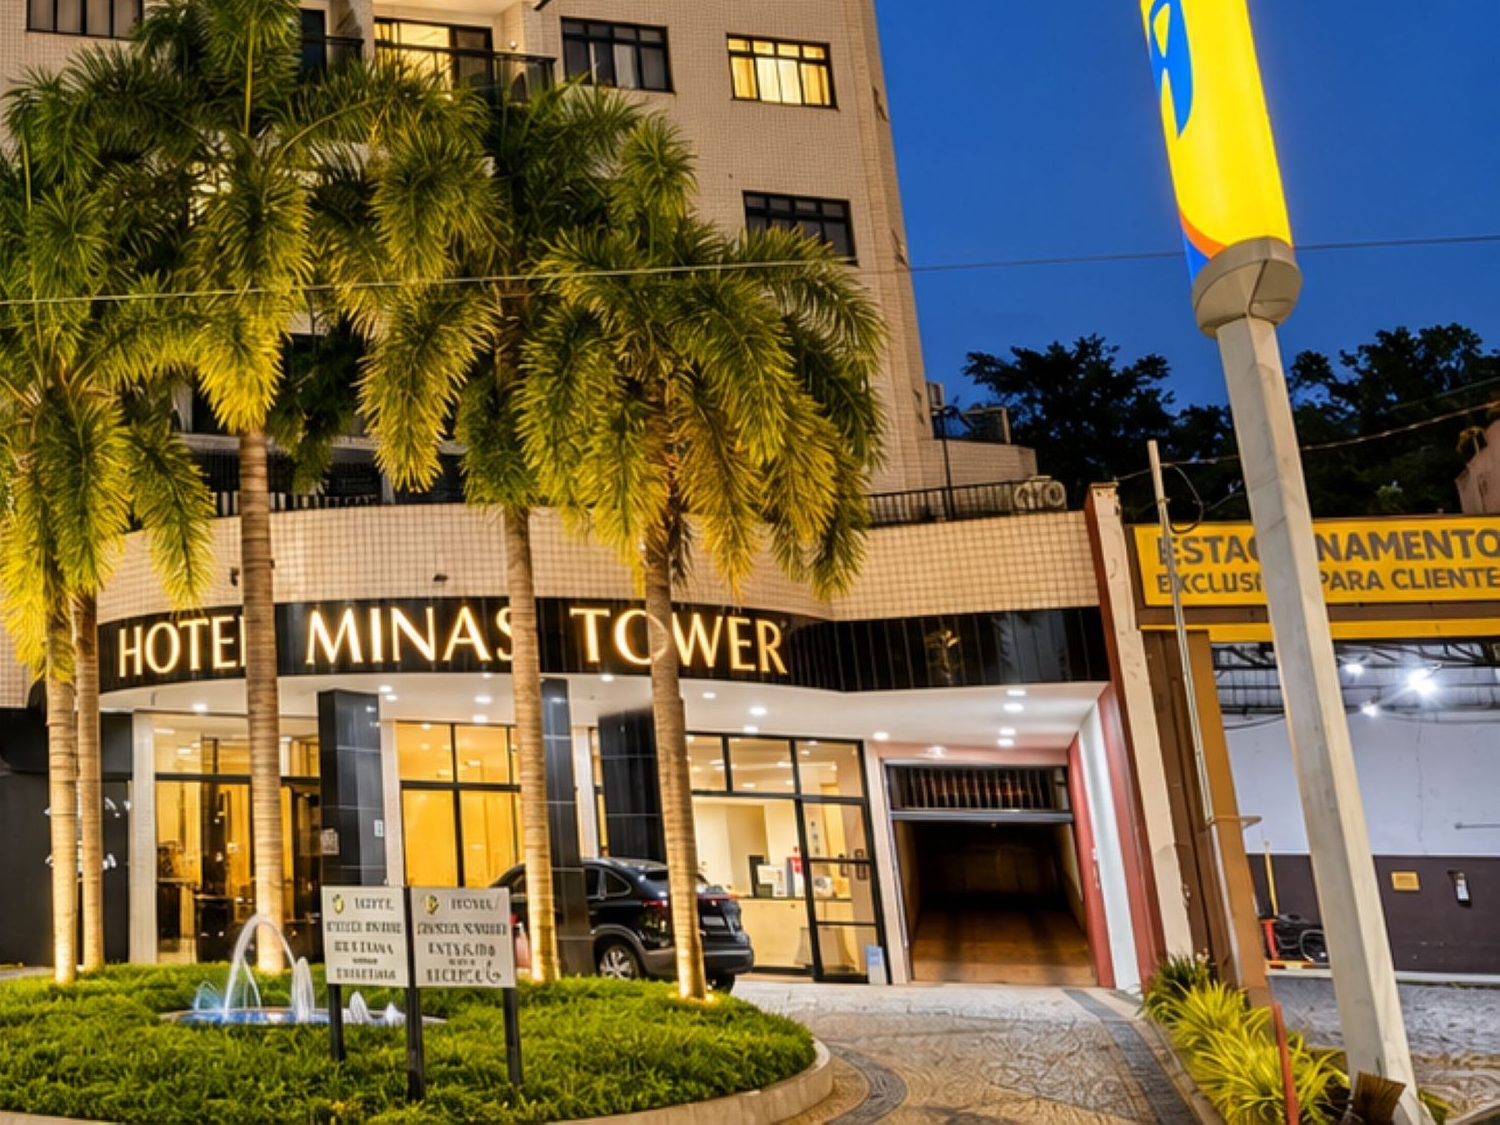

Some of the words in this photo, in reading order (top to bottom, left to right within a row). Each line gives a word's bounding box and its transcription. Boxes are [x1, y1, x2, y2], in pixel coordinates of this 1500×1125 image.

[1157, 528, 1500, 565] ESTACNAMENTO
[1156, 572, 1262, 594] EXCLUSI
[306, 606, 514, 664] MINAS
[569, 608, 787, 674] TOWER
